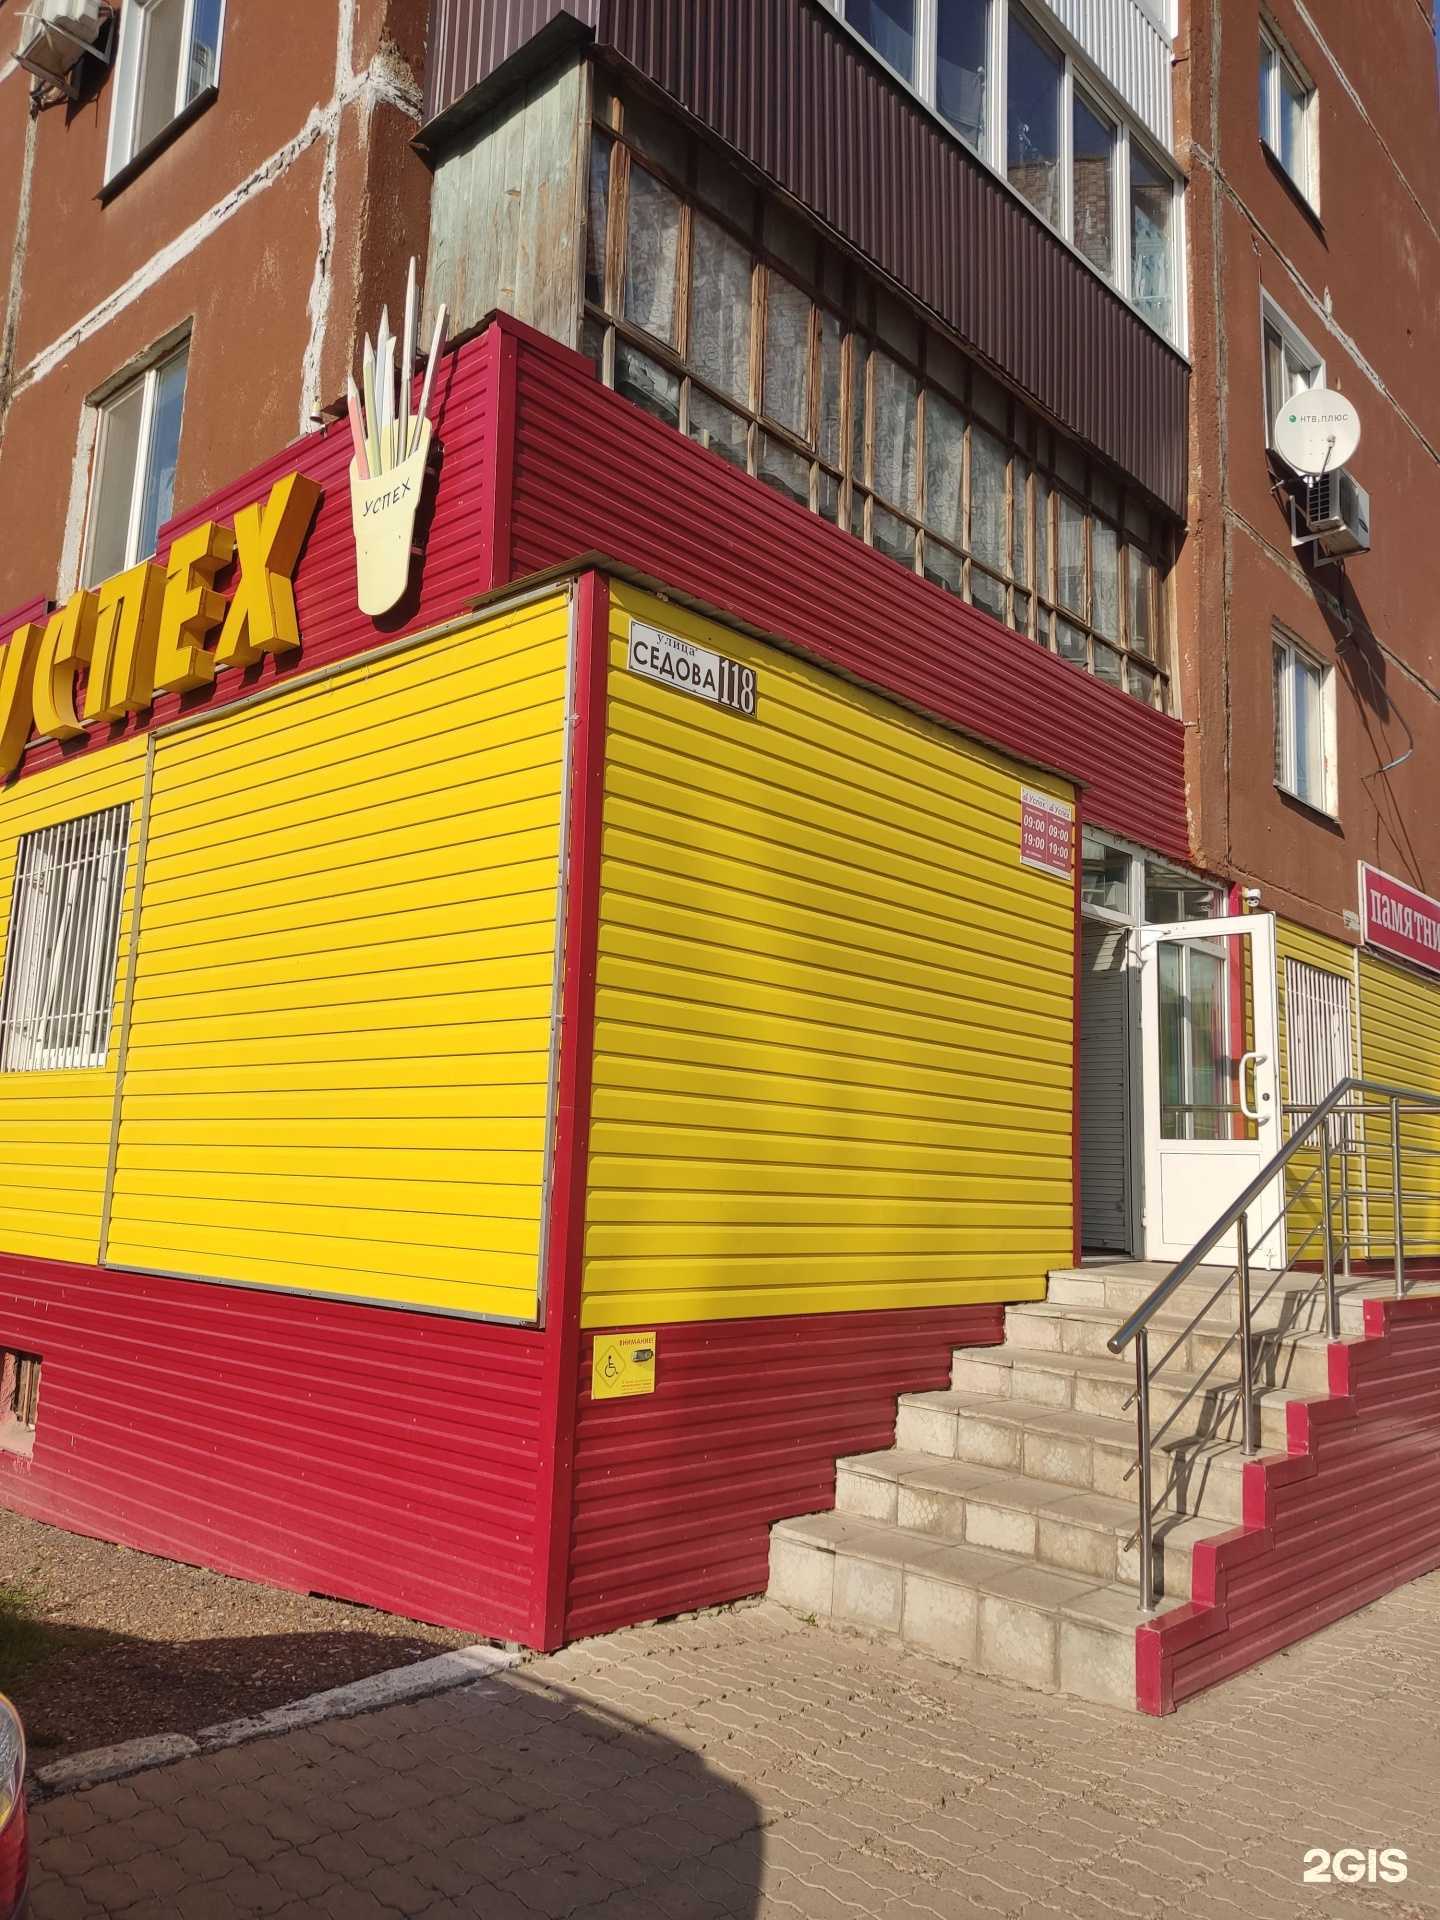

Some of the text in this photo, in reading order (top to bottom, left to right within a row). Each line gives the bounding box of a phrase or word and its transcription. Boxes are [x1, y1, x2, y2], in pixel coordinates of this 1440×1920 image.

[362, 477, 411, 517] УСПЕХ
[657, 633, 696, 657] улица
[633, 640, 754, 714] СЕДОВА 118
[1023, 814, 1046, 833] 09:00
[1048, 824, 1069, 843] 09:00
[1023, 832, 1046, 851] 19:00
[1048, 842, 1069, 860] 19:00
